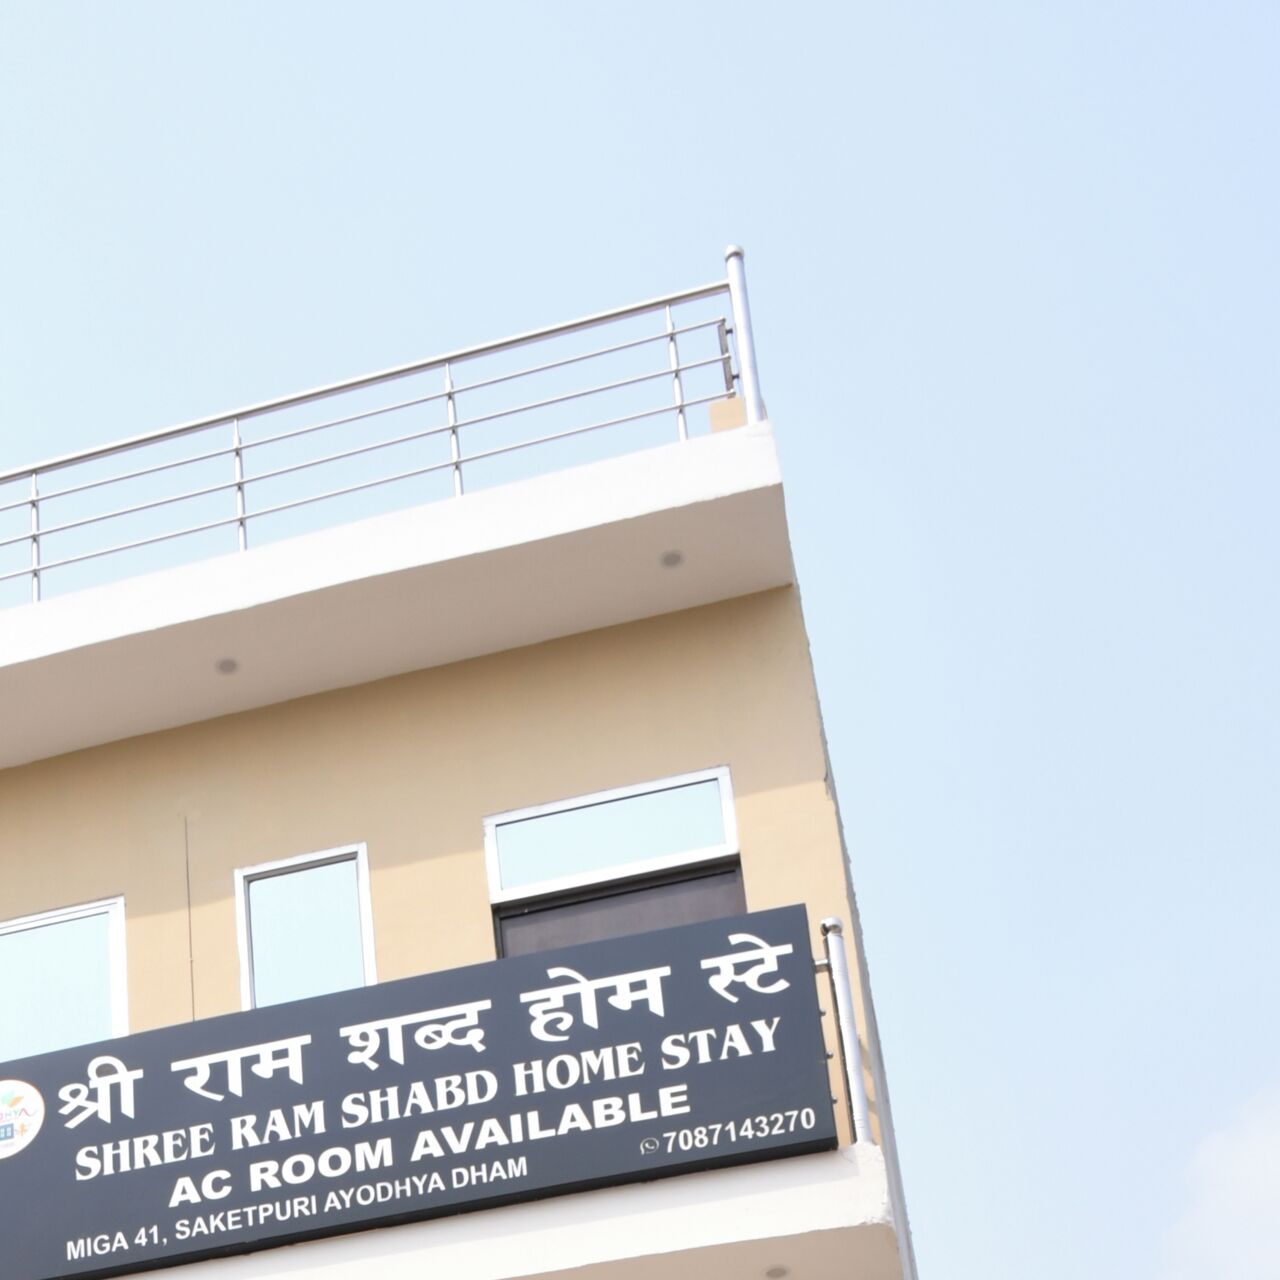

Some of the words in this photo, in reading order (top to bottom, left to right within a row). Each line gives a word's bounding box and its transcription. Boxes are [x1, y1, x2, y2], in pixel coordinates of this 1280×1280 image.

[58, 1056, 143, 1129] श्री
[171, 1035, 311, 1102] राम
[340, 999, 491, 1071] शब्द
[520, 966, 671, 1042] होम
[701, 933, 794, 1004] स्टे
[76, 1122, 216, 1181] SHREE
[231, 1101, 327, 1151] RAM
[342, 1070, 498, 1129] SHABD
[513, 1042, 645, 1097] HOME
[661, 1017, 781, 1070] STAY
[169, 1170, 233, 1208] AC
[250, 1138, 394, 1193] ROOM
[411, 1084, 691, 1162] AVAILABLE
[663, 1108, 816, 1157] 7087143270
[67, 1232, 129, 1261] MIGA
[135, 1225, 168, 1249] 41,
[176, 1194, 317, 1240] SAKETPURI
[324, 1172, 446, 1213] AYODHYA
[452, 1157, 528, 1189] DHAM
